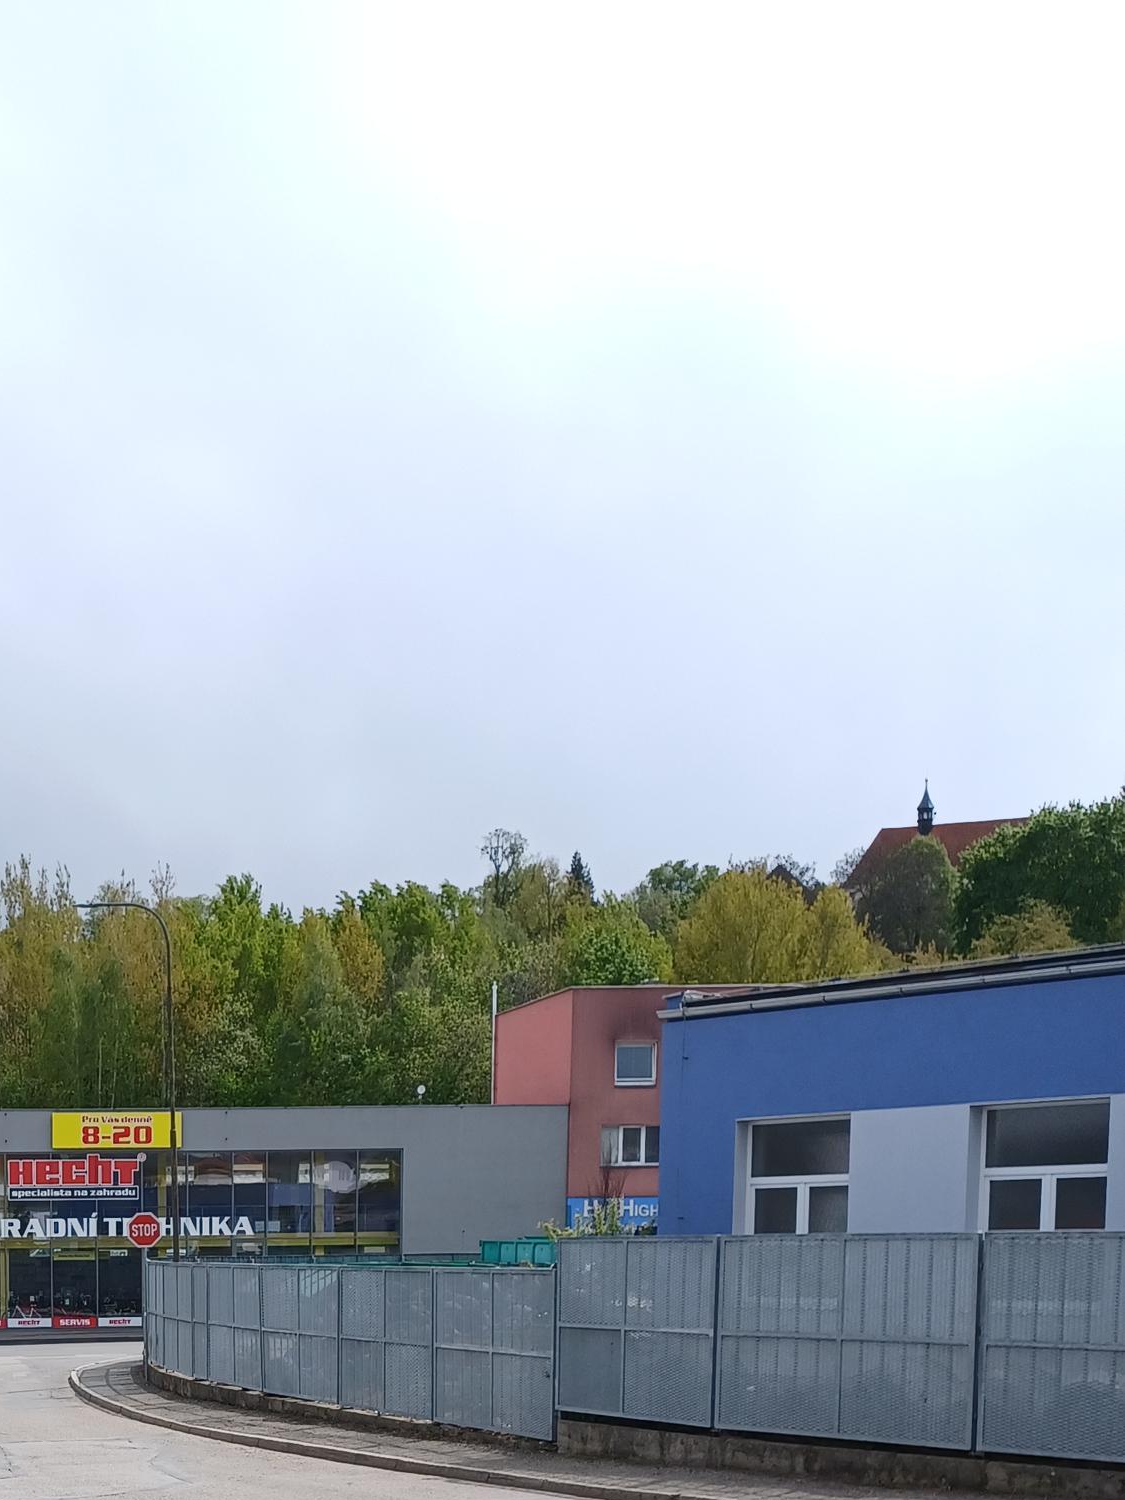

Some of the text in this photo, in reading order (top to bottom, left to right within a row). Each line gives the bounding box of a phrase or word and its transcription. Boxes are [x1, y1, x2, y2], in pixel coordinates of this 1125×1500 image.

[82, 1126, 152, 1144] 8-20
[11, 1189, 72, 1199] specialista
[89, 1188, 136, 1197] zahradu
[103, 1217, 255, 1236] THNIKA
[131, 1223, 158, 1237] STOP
